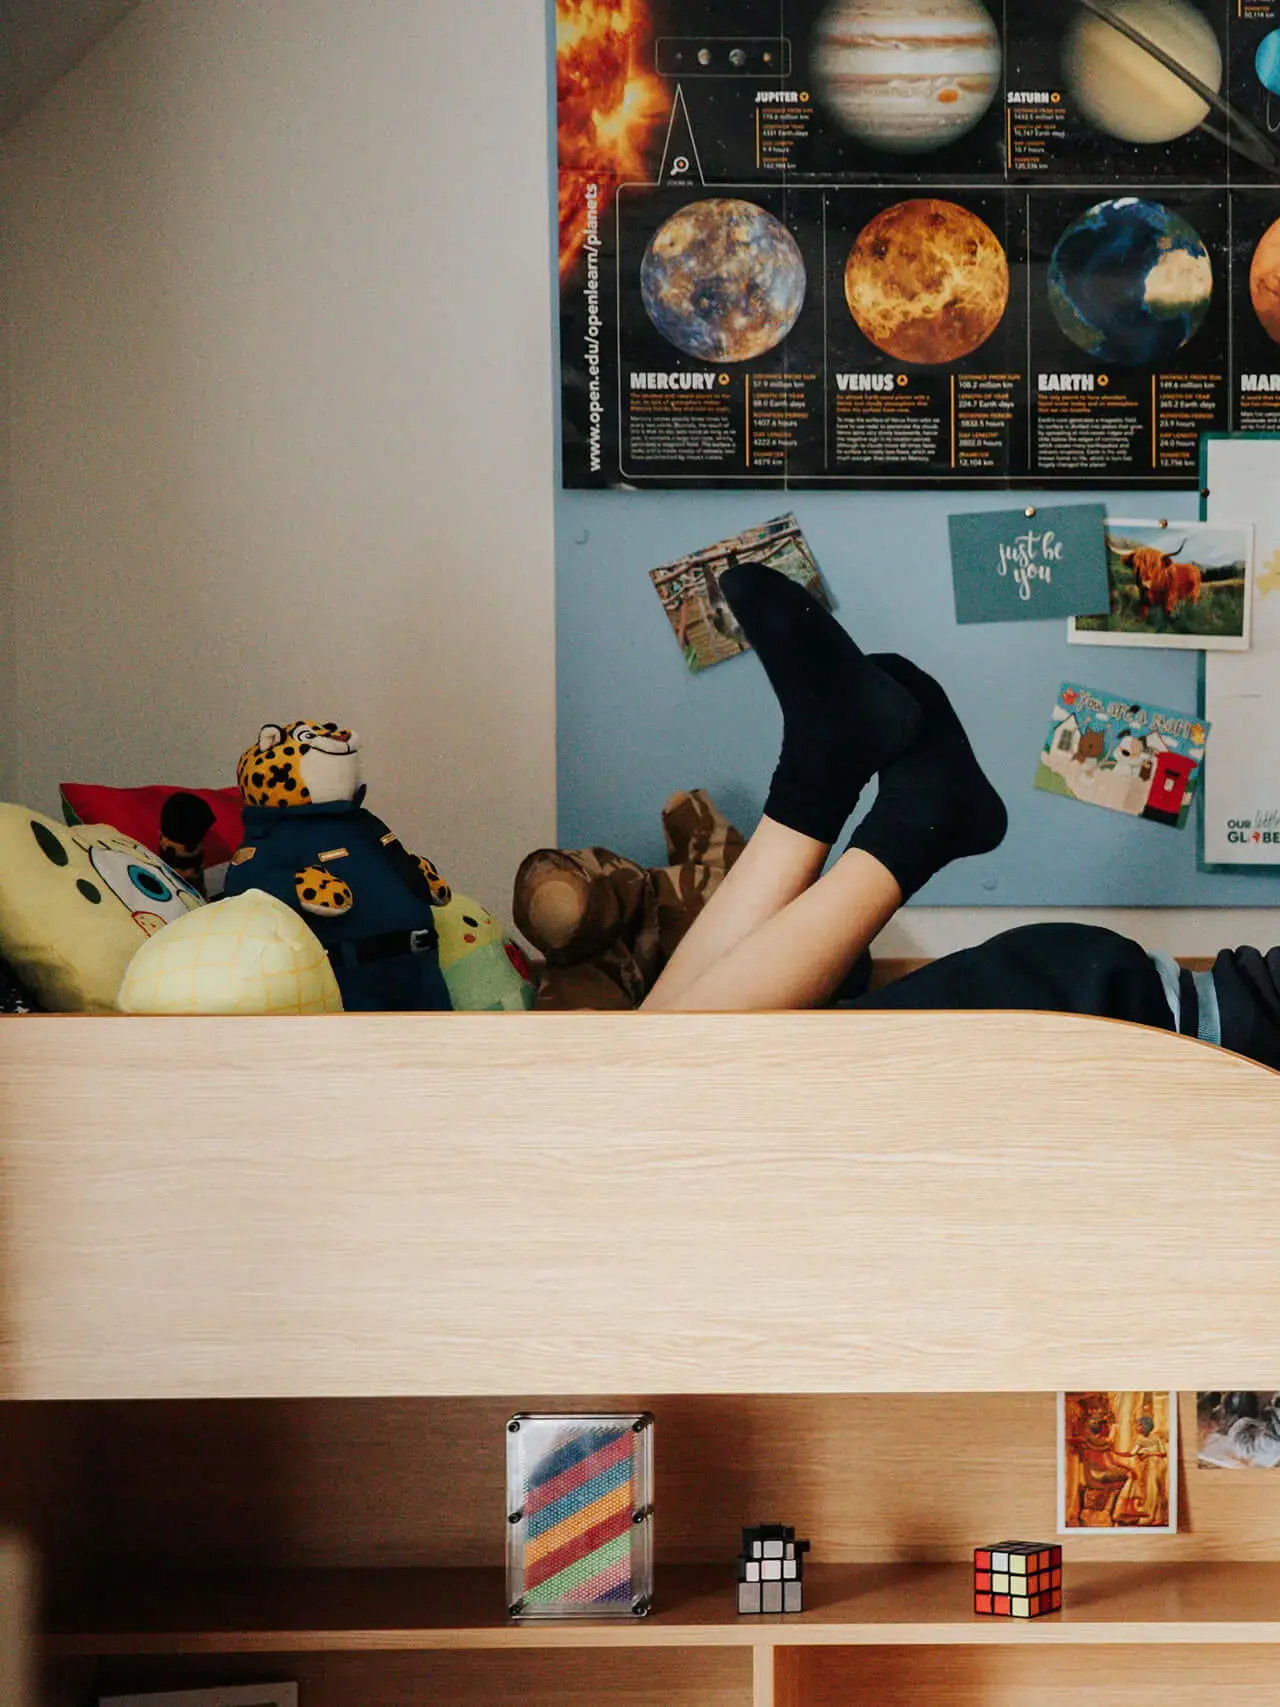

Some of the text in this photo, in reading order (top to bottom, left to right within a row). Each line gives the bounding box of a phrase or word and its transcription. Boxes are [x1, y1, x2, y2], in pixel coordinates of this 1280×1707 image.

[754, 91, 799, 103] JUPITER
[1007, 91, 1050, 104] SATURN
[583, 183, 603, 471] www.open.edu/openlearn/planets
[630, 372, 716, 390] MERCURY
[836, 374, 894, 391] VENUS
[1002, 381, 1014, 389] km
[1038, 374, 1094, 391] EARTH
[1203, 381, 1215, 389] km
[979, 400, 997, 409] Earth
[998, 400, 1015, 409] days
[1180, 401, 1197, 409] Earth
[1200, 401, 1216, 409] days
[778, 420, 798, 428] hours
[985, 420, 1005, 428] hours
[1176, 420, 1195, 428] hours
[983, 439, 1002, 447] hours
[983, 459, 994, 467] km
[998, 530, 1063, 576] just be
[1013, 563, 1051, 600] you
[1227, 819, 1252, 829] OUR
